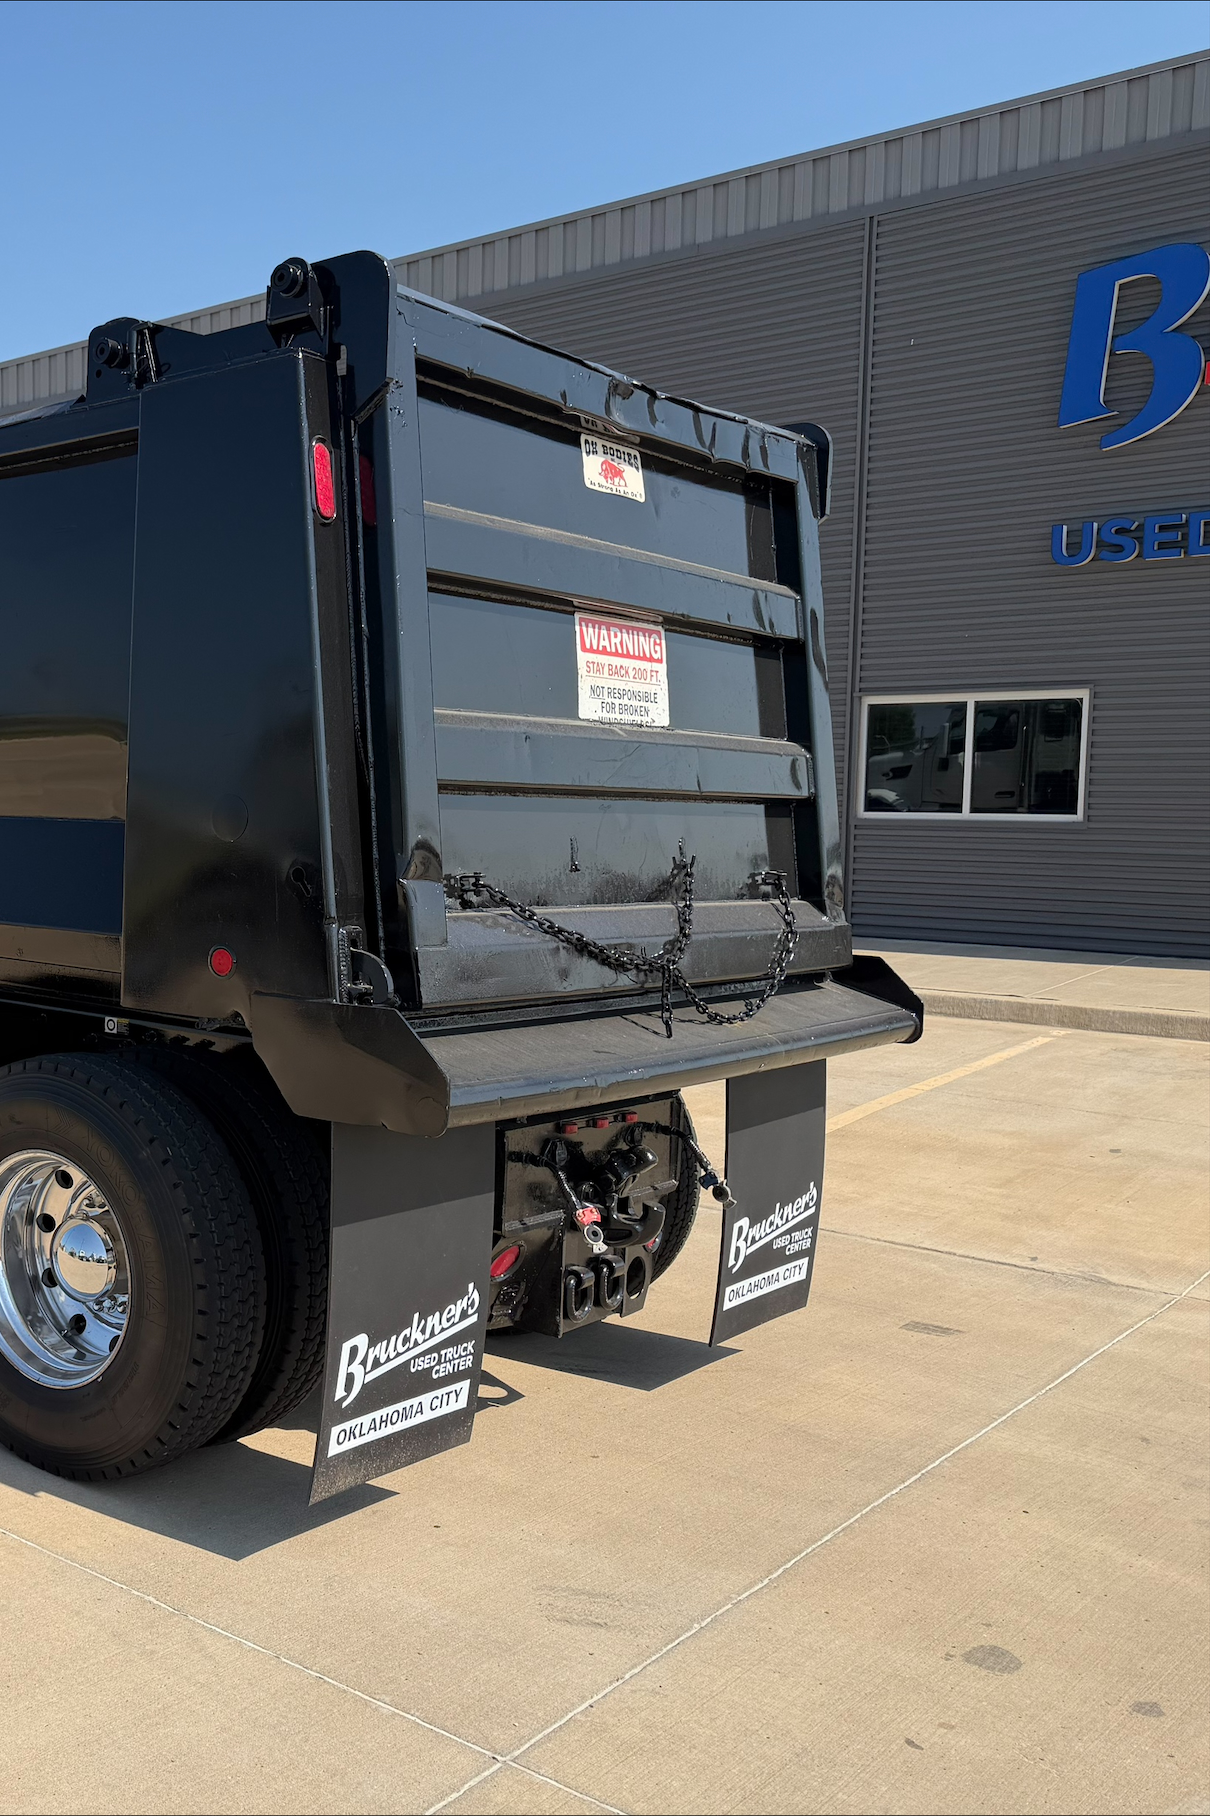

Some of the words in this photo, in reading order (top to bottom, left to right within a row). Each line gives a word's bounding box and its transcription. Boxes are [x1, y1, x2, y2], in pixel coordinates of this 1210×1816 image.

[601, 443, 640, 473] BODIES
[581, 621, 662, 660] WARNING
[585, 660, 605, 675] STAY
[607, 663, 630, 679] BACK
[632, 667, 648, 681] 200
[650, 669, 661, 683] FT.
[590, 684, 606, 698] NOT
[607, 686, 658, 704] RESPONSIBLE
[601, 701, 616, 714] FOR
[618, 703, 650, 717] BROKEN
[82, 1126, 166, 1315] YOKOHAMA
[728, 1181, 817, 1275] Bruckner's
[772, 1234, 791, 1250] USED
[791, 1226, 814, 1243] TRUCK
[785, 1238, 812, 1256] CENTER
[728, 1272, 780, 1303] OKLAHOMA
[783, 1262, 805, 1281] CITY
[334, 1282, 480, 1409] Bruckner's
[410, 1353, 439, 1373] USED
[440, 1340, 476, 1362] TRUCK
[432, 1355, 474, 1380] CENTER
[336, 1401, 424, 1446] OKLAHOMA
[429, 1386, 464, 1412] CITY
